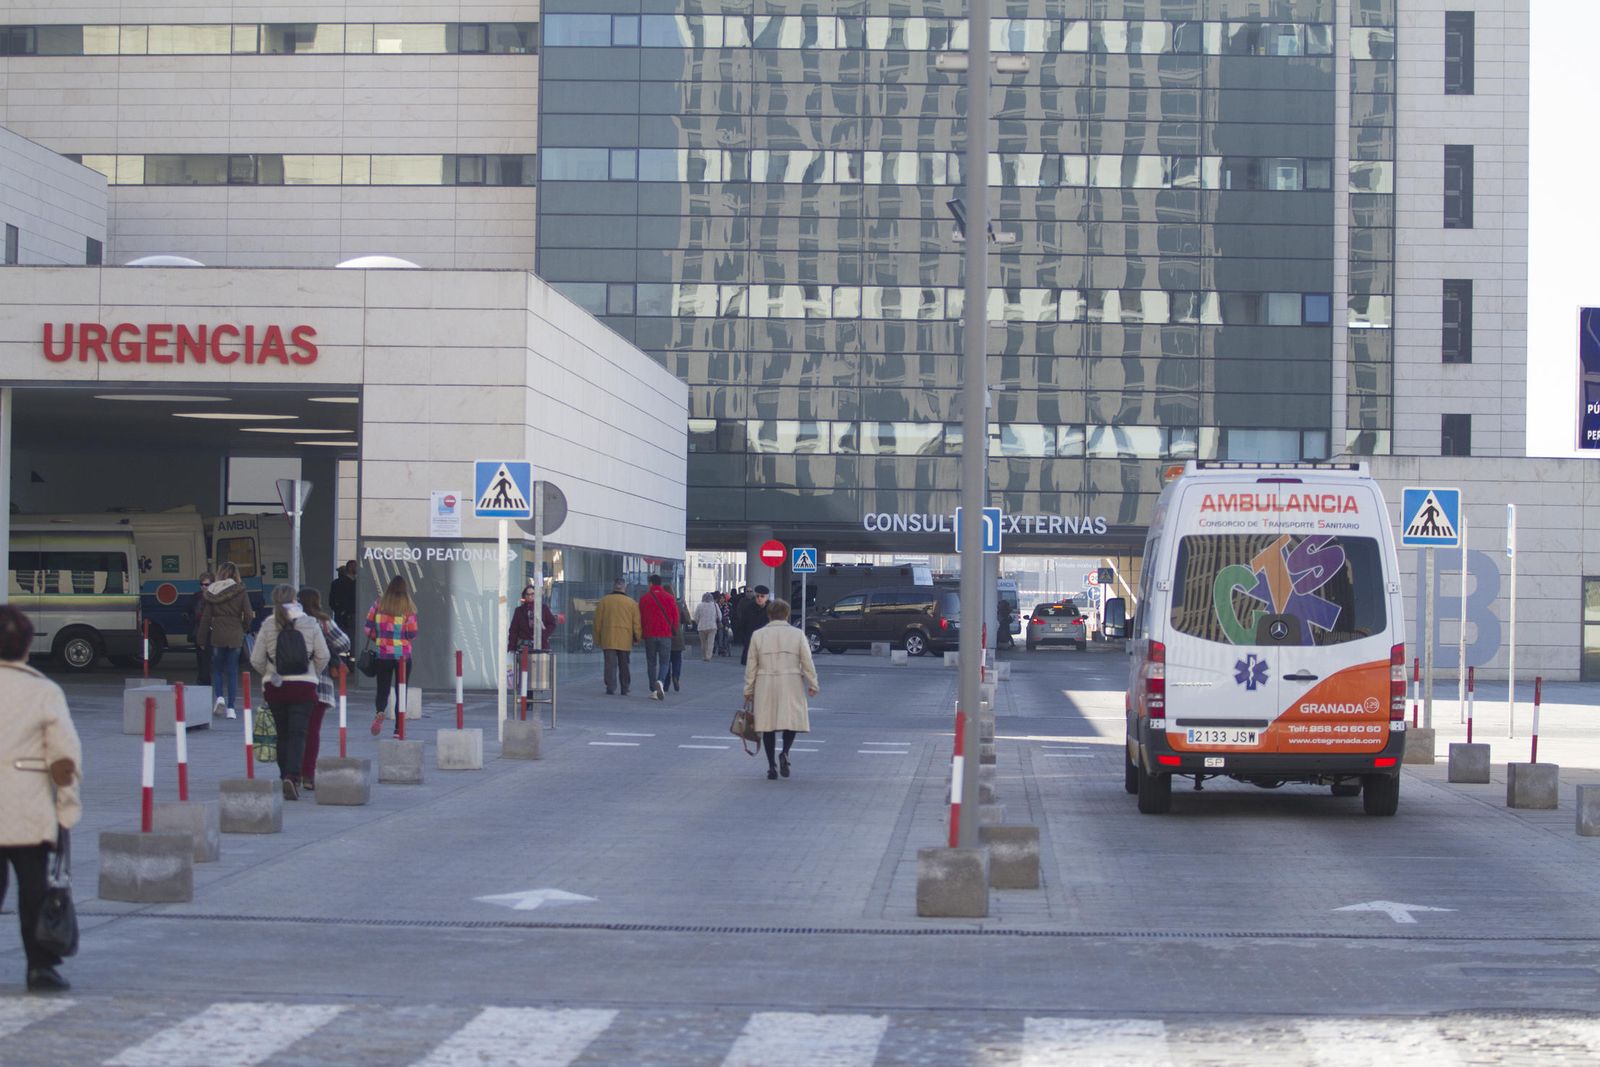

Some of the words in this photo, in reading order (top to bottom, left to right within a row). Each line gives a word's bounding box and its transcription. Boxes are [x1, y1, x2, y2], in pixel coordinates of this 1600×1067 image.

[43, 322, 319, 366] URGENCIAS
[1200, 493, 1360, 514] AMBULANCIA
[863, 512, 956, 533] CONSULT
[1199, 518, 1245, 527] CONSORCIO
[1263, 518, 1315, 528] TRANSPORTE
[1318, 519, 1360, 530] SANITARIO
[364, 547, 422, 561] ACCESO
[1416, 549, 1502, 668] B
[1300, 703, 1364, 714] GRANADA
[1309, 725, 1332, 733] 958
[1333, 725, 1348, 733] 40
[1350, 725, 1365, 733] 60
[1366, 725, 1381, 733] 60
[1195, 730, 1227, 743] 2133
[1232, 731, 1256, 743] JSW
[1288, 737, 1381, 745] www.ctsgranada.com
